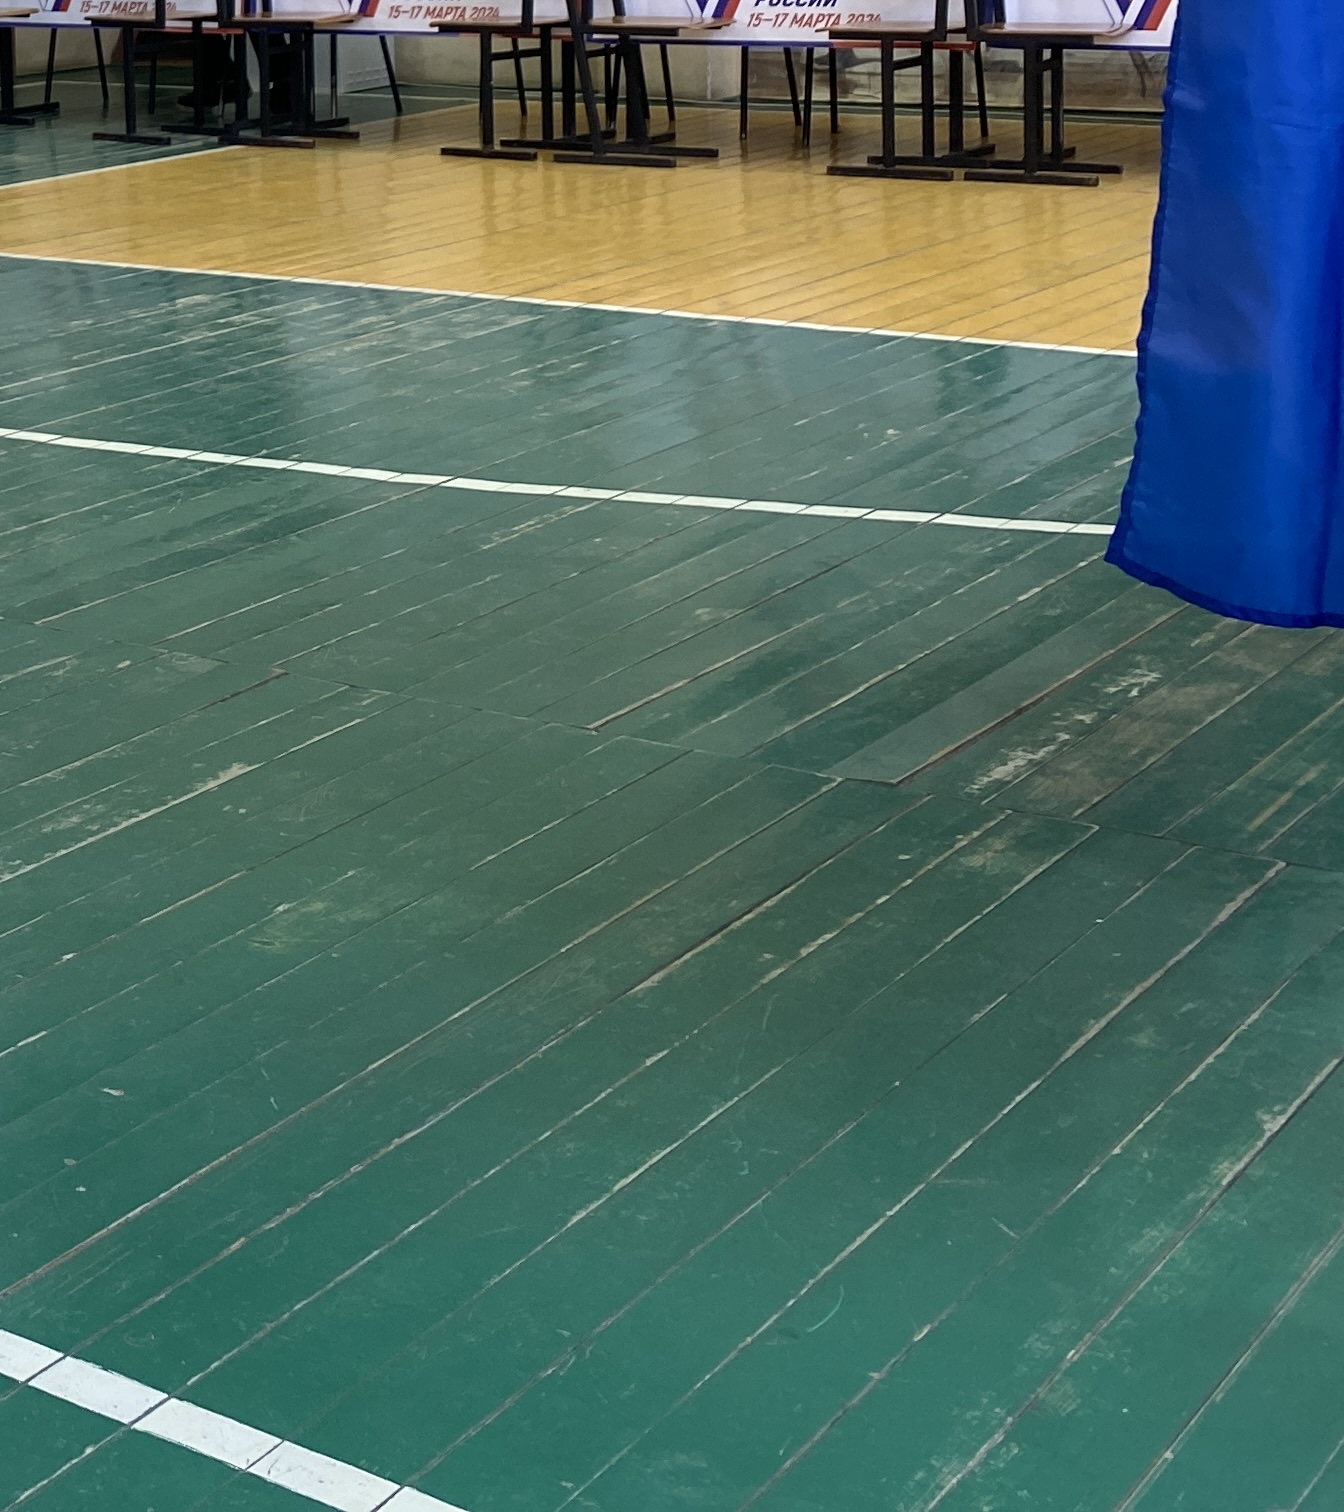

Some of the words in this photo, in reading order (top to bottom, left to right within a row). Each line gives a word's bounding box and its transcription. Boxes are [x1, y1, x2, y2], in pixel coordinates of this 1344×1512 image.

[111, 1, 149, 15] МАРТА
[424, 6, 466, 20] МАРТА
[789, 13, 840, 28] МАРТА
